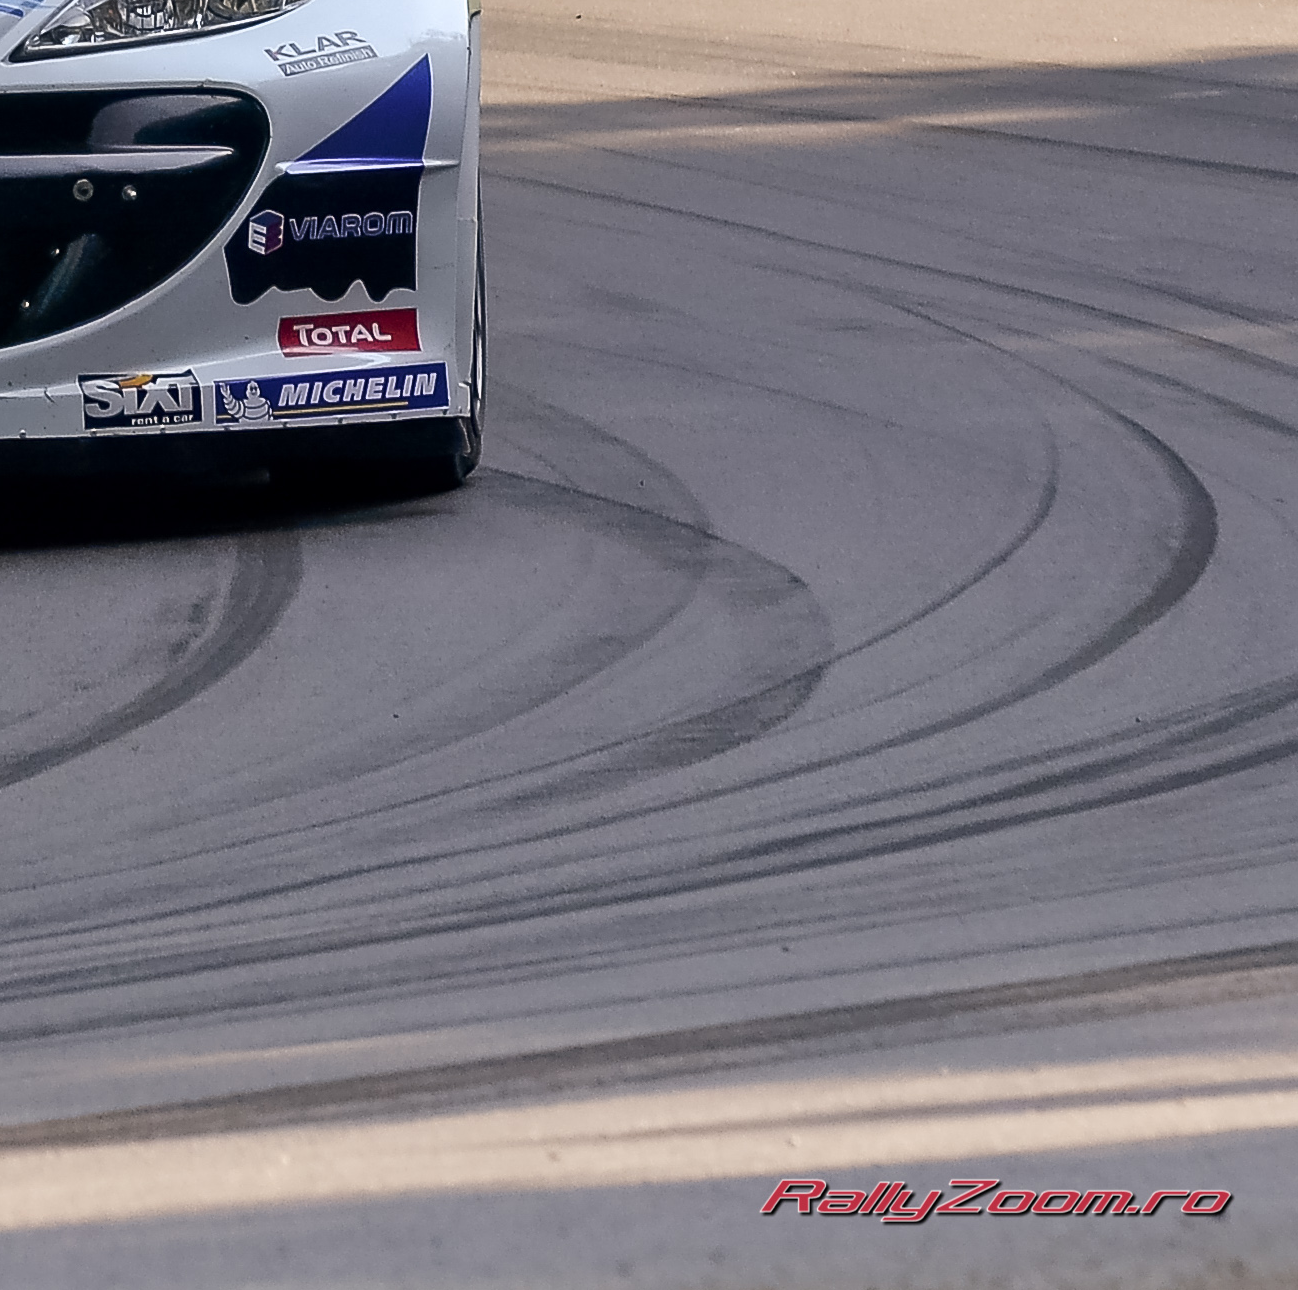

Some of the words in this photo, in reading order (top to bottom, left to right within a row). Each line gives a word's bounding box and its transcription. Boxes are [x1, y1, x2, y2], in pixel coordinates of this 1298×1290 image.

[264, 30, 367, 62] KLAR
[284, 58, 317, 75] Auto
[317, 47, 373, 67] Refinish
[289, 211, 414, 241] VIAROM
[278, 372, 438, 407] MICHELIN
[131, 416, 160, 426] rent
[176, 413, 194, 423] car
